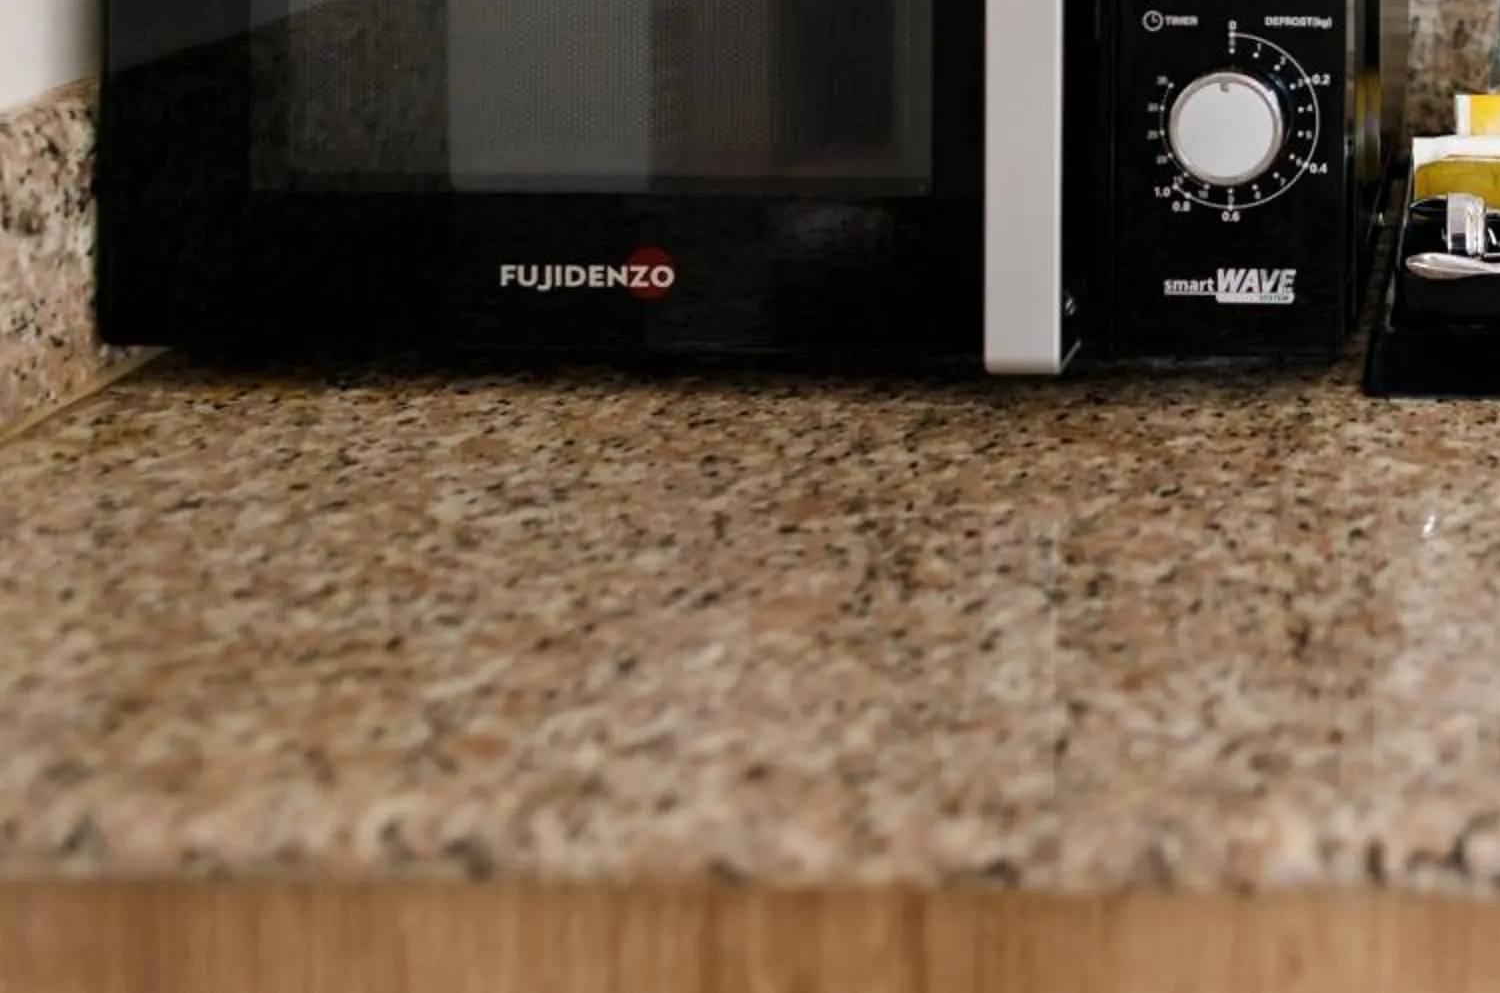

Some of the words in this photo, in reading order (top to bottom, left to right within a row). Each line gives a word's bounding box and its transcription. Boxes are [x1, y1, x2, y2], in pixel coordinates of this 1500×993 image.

[1165, 15, 1199, 26] TIMER
[1311, 73, 1332, 86] 0.2
[1309, 162, 1328, 175] 0.4
[1153, 185, 1171, 198] 1.0
[1171, 200, 1192, 212] 0.8
[1221, 210, 1241, 223] 0.6
[500, 263, 676, 291] FUJIDENZO
